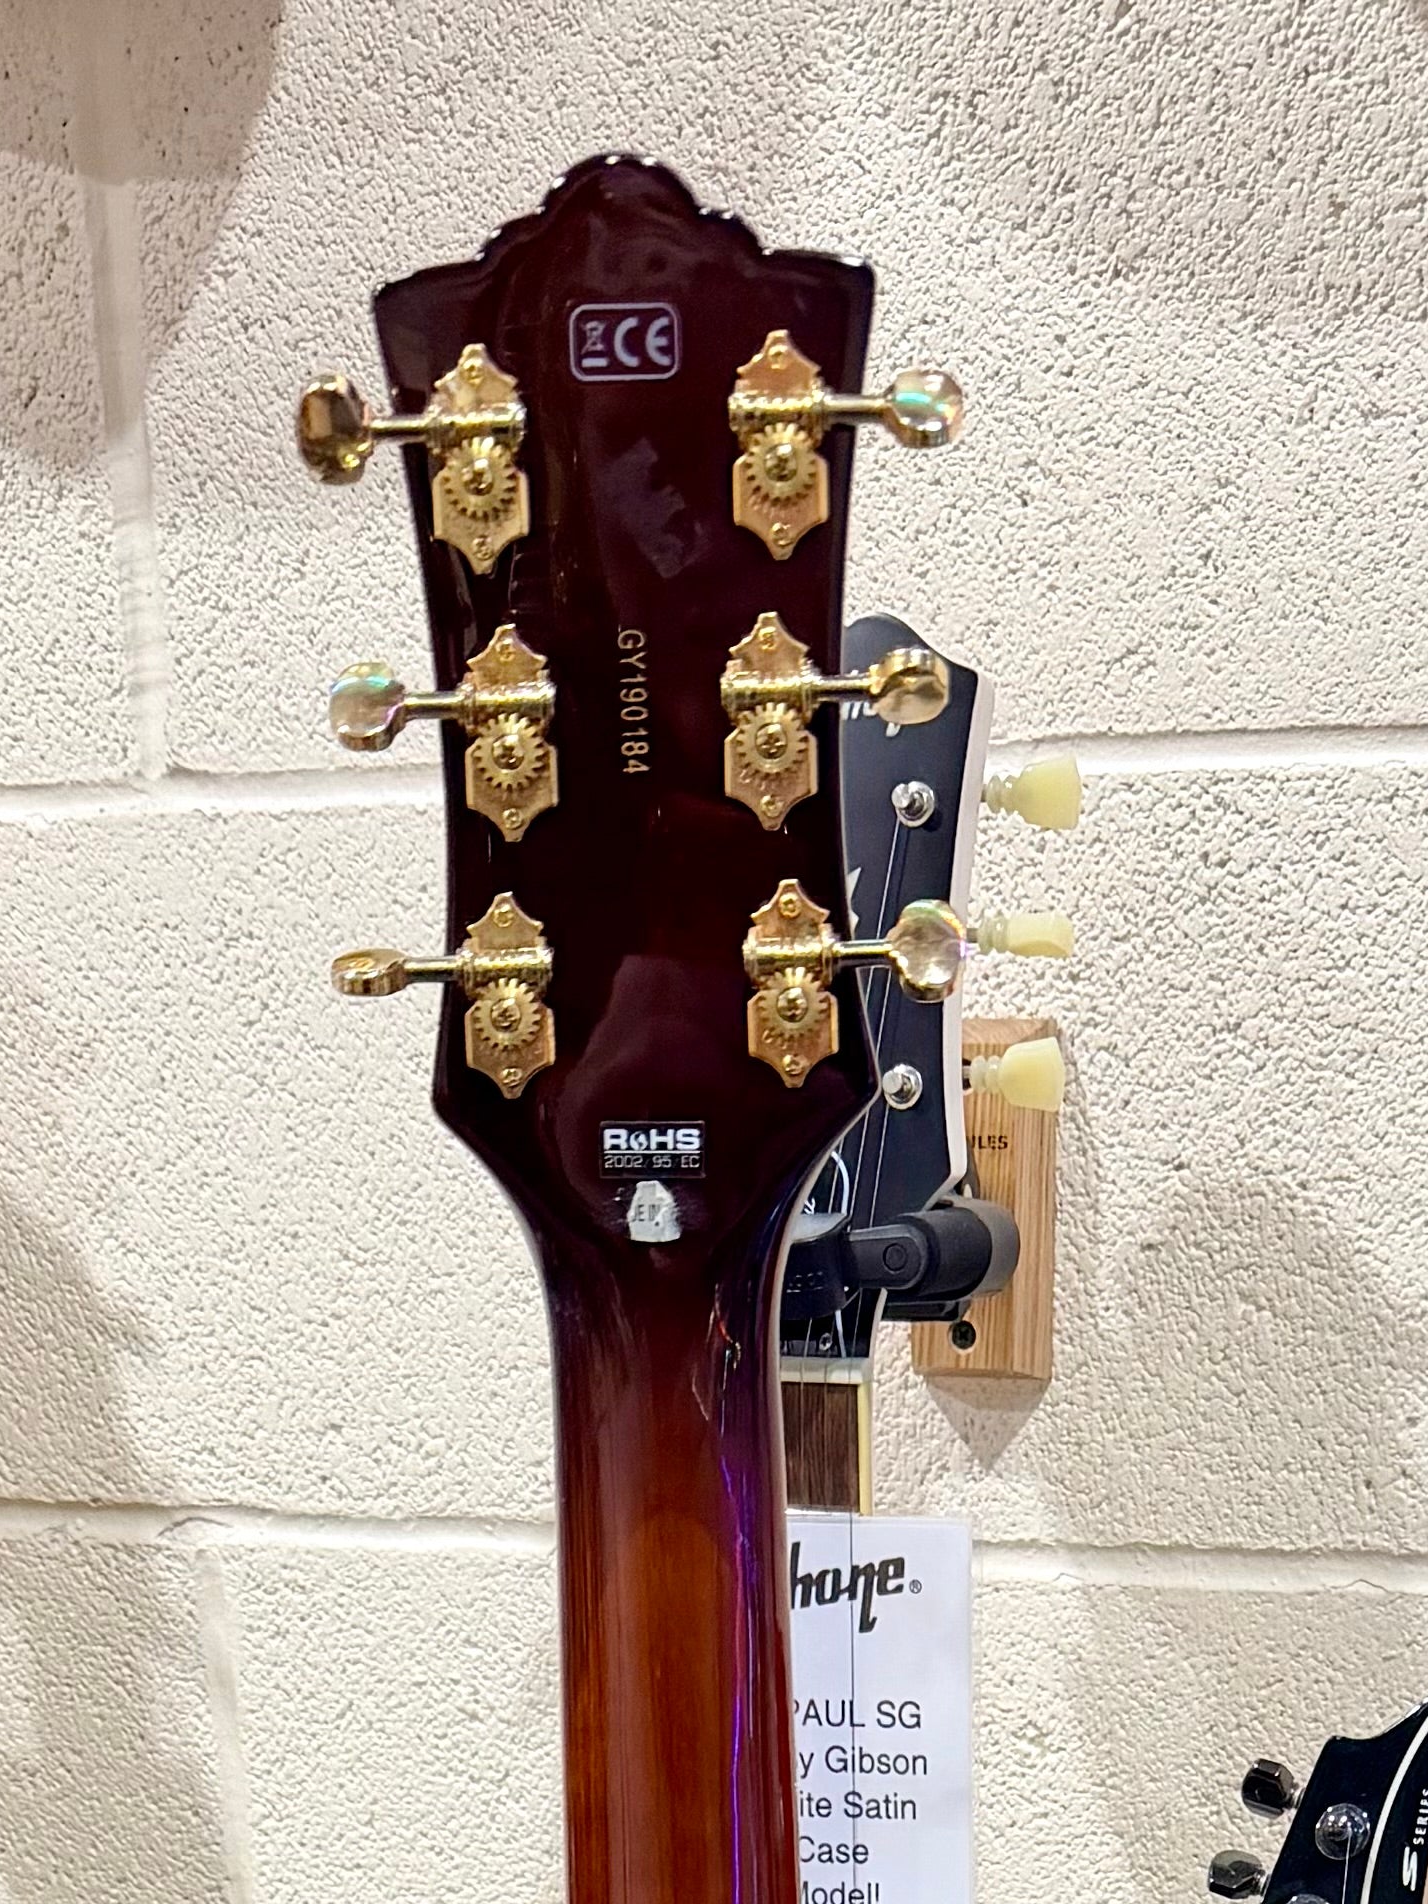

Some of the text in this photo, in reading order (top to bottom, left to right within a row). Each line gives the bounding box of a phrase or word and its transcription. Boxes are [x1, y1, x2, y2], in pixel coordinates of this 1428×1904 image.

[617, 628, 651, 774] GY190184
[876, 1700, 922, 1730] SG
[824, 1745, 928, 1777] Gibson
[843, 1790, 917, 1821] Satin
